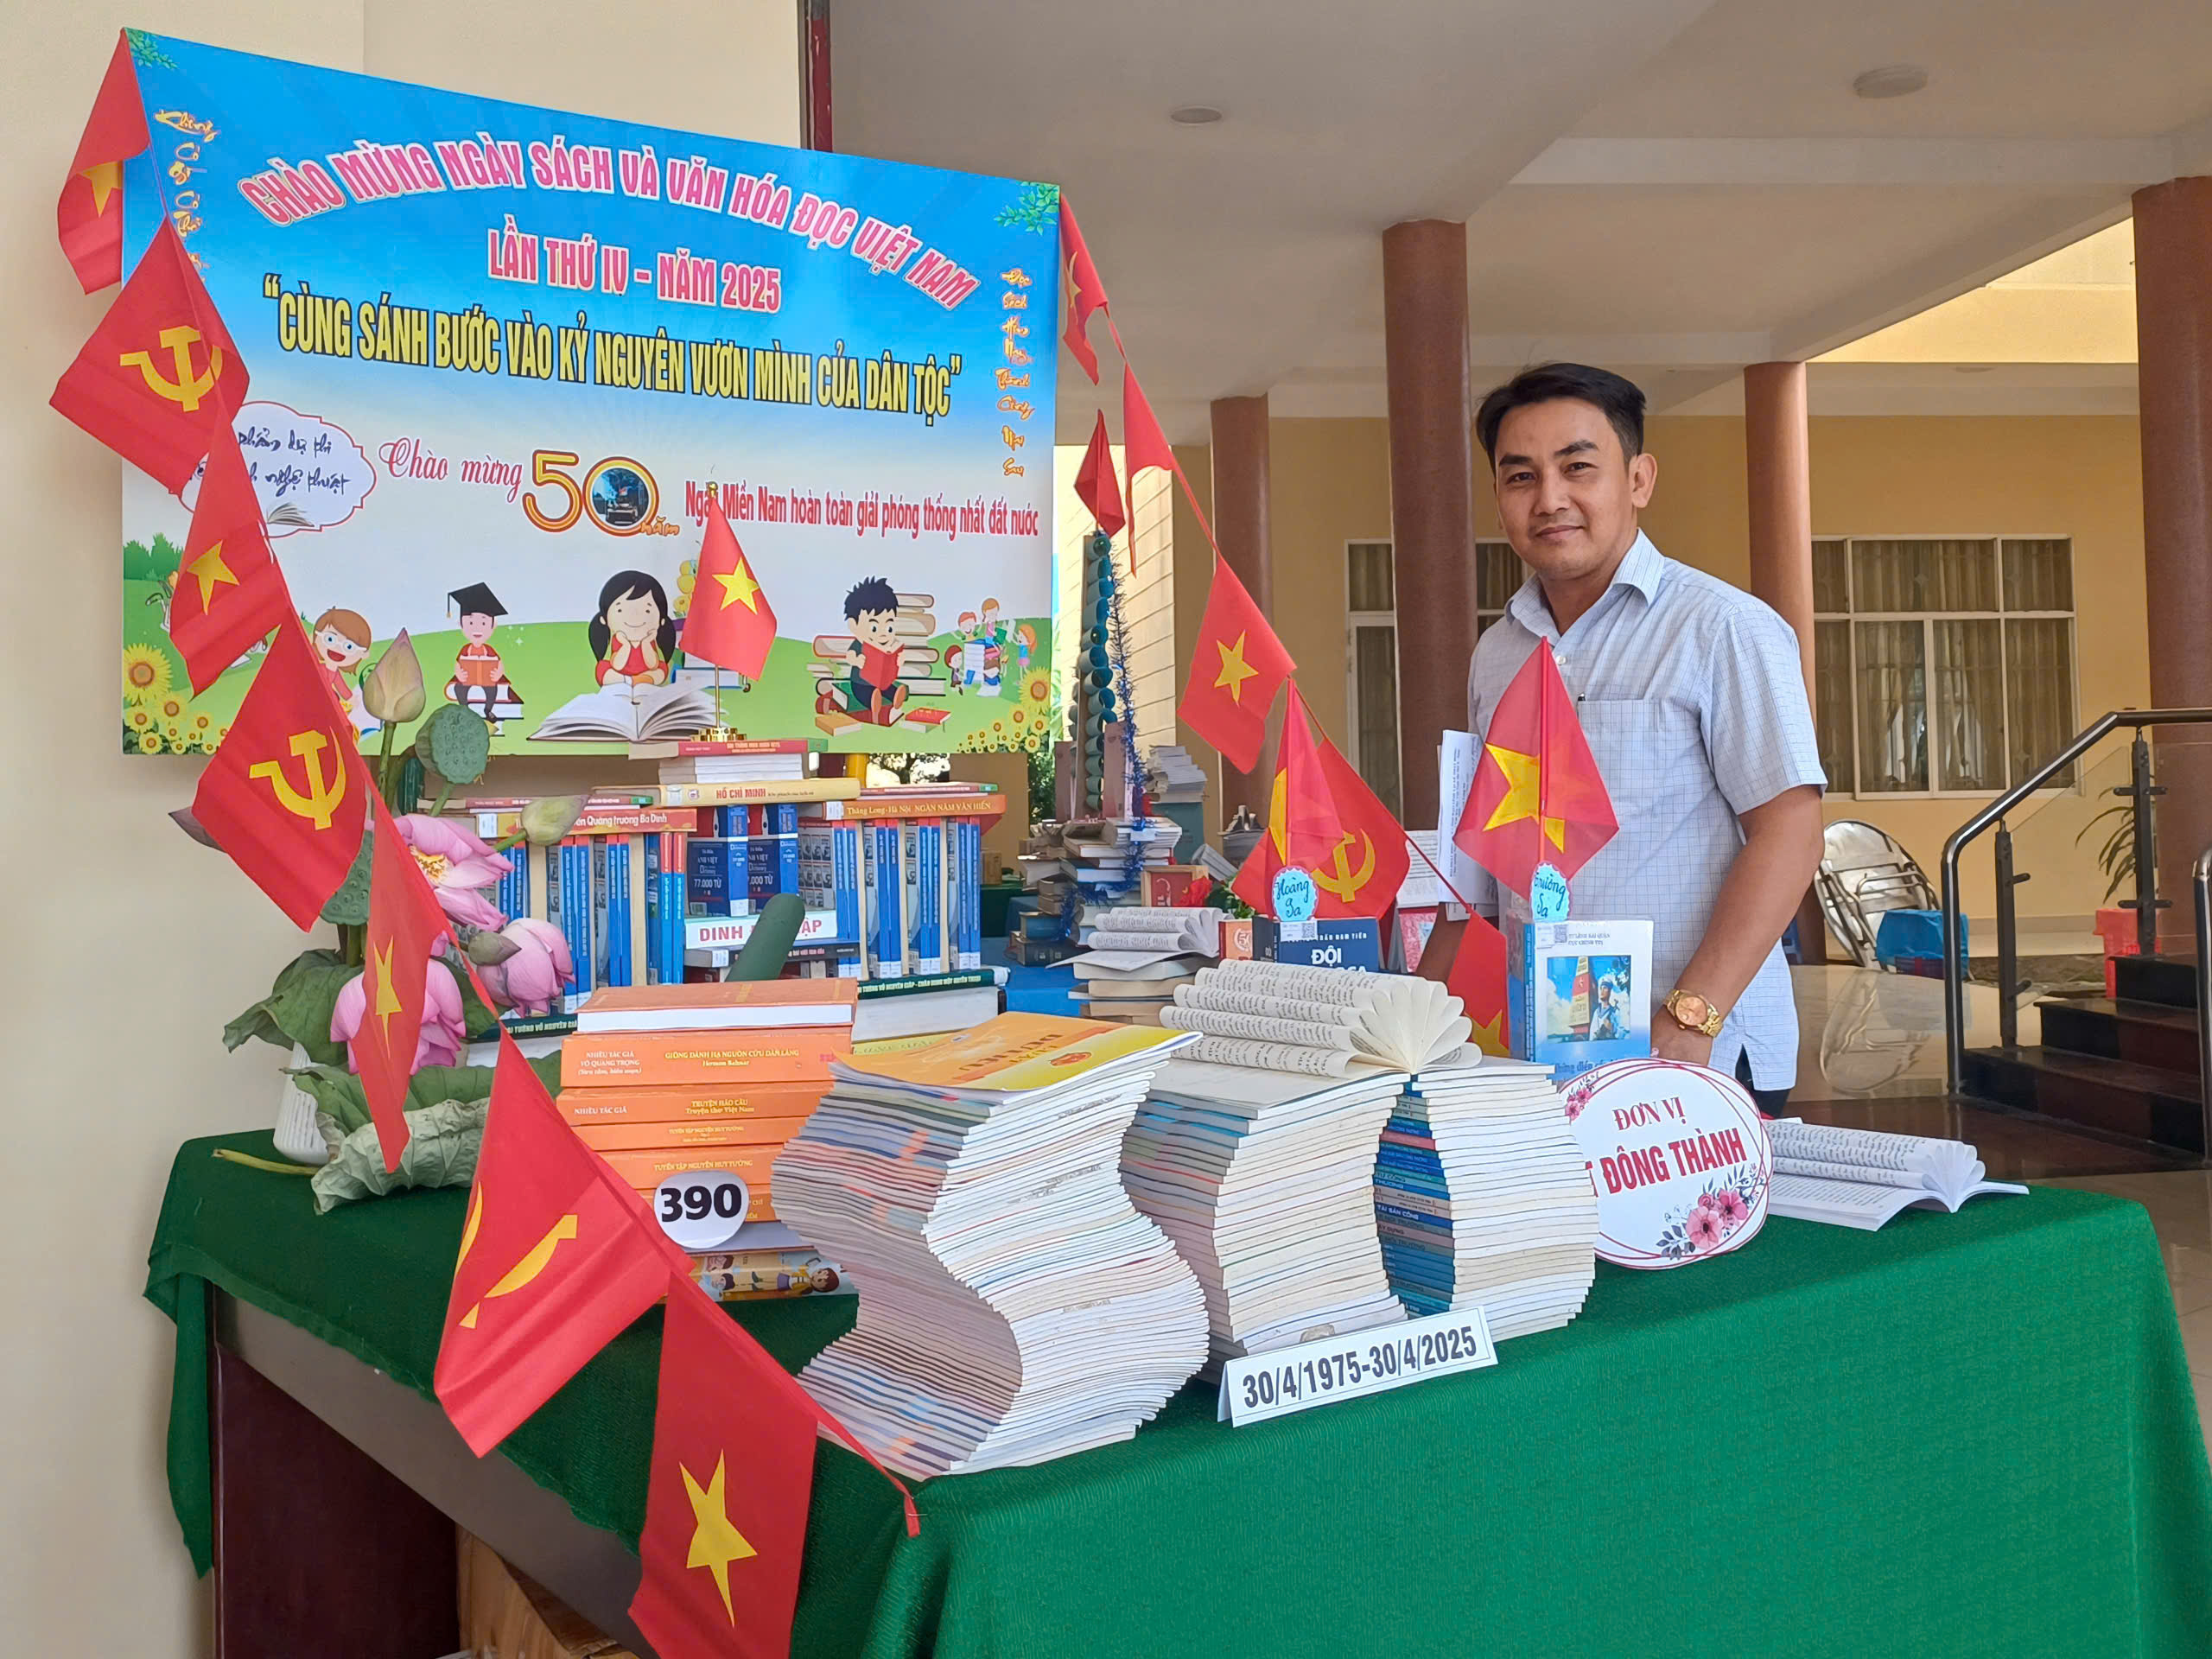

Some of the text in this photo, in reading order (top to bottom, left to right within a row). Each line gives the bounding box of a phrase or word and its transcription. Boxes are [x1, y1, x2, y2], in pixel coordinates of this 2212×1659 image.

[239, 132, 981, 310] CHÀO MỪNG NGÀY SÁCH VÀ VĂN HÓA ĐỌC VIỆT NAM
[488, 213, 538, 283] LẦN
[543, 233, 597, 290] THỨ
[601, 245, 629, 295] IV
[658, 247, 716, 306] NĂM
[721, 263, 781, 315] 2025
[358, 292, 429, 367] SÁNH
[434, 304, 500, 375] BƯỚC
[505, 310, 553, 380] VÀO
[558, 312, 590, 385] KỶ
[594, 326, 685, 394] NGUYÊN
[689, 338, 749, 399] VƯƠN
[753, 339, 811, 405] MÌNH
[817, 338, 861, 410] CỦA
[865, 350, 908, 413] DÂN
[264, 464, 303, 497] nghệ
[308, 467, 351, 495] thuật
[378, 437, 680, 537] Chào mừng 50 năm
[685, 480, 1039, 542] Ngà Miền Nam hoàn toàn giải phóng thống nhất đất nước
[745, 787, 766, 798] MINH
[640, 813, 649, 823] Ba
[868, 806, 885, 816] Long
[694, 878, 713, 887] 77.000
[748, 876, 764, 885] .000
[1275, 877, 1309, 904] Hoàng
[700, 925, 743, 942] DINH
[798, 918, 822, 937] ẬP
[1311, 945, 1342, 967] ĐỘI
[1612, 1096, 1687, 1131] ĐƠN VỊ
[1600, 1145, 1671, 1195] ĐÔNG
[1668, 1128, 1748, 1178] THÀNH
[661, 1184, 742, 1222] 390
[1242, 1325, 1477, 1408] 30/4/1975-30/4/2025
